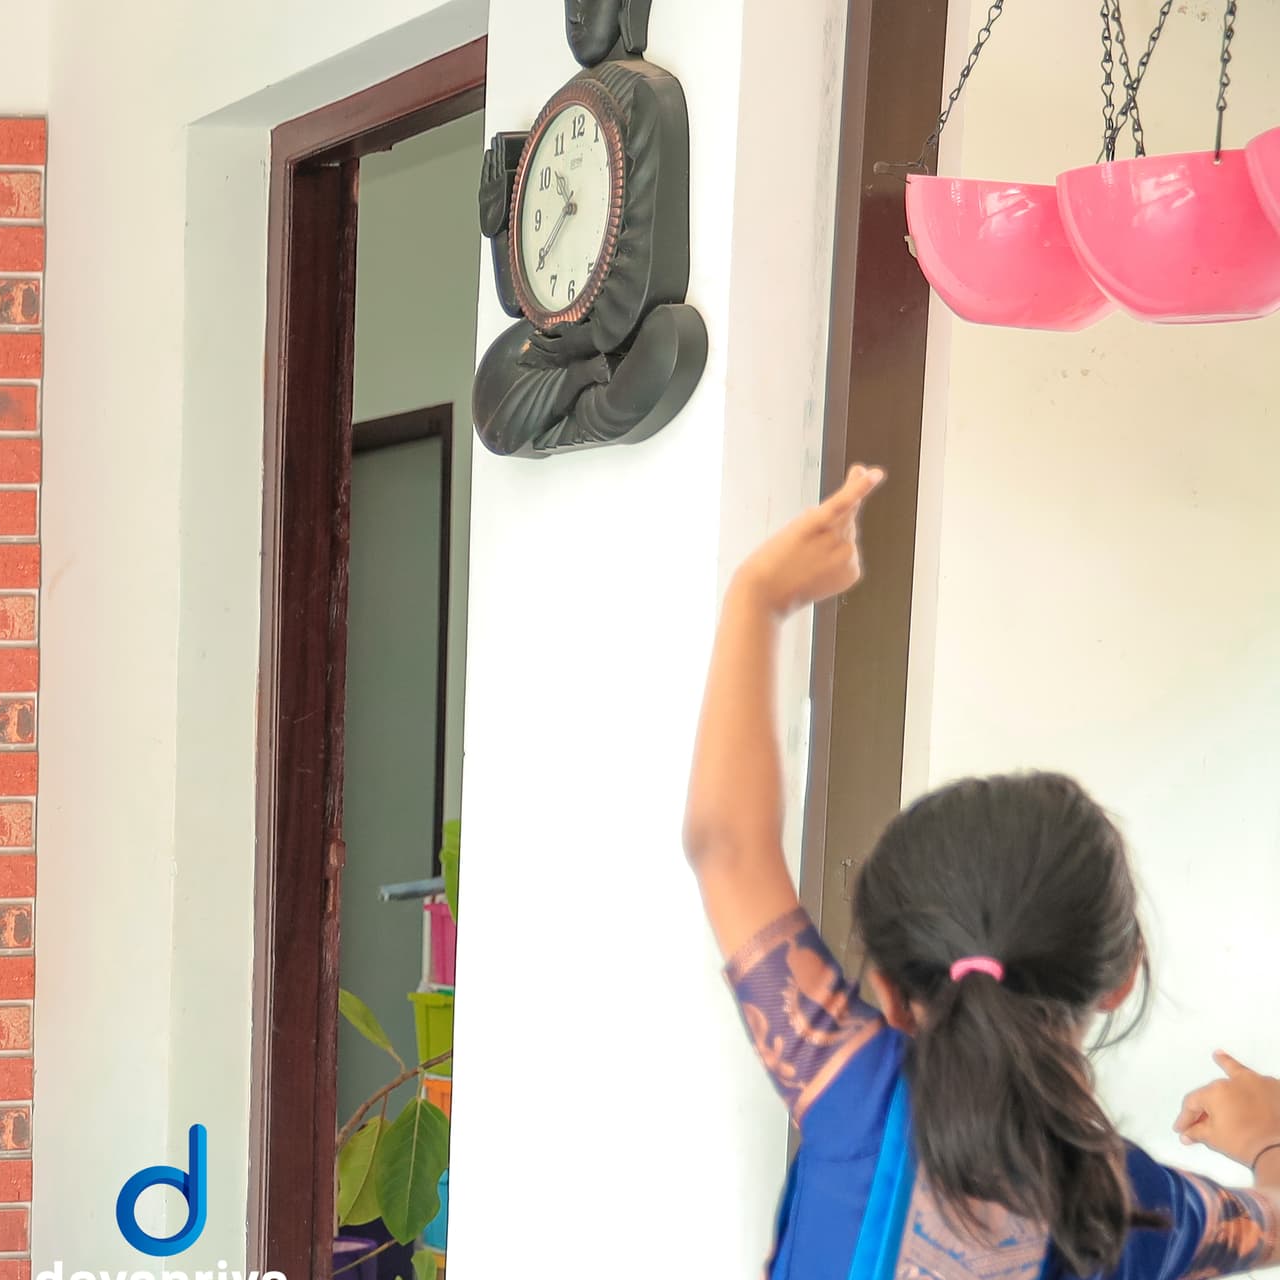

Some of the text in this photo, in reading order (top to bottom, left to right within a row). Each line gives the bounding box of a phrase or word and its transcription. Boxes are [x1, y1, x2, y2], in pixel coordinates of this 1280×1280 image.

[571, 113, 585, 139] 12
[593, 123, 600, 143] 1
[554, 132, 564, 157] 11
[539, 166, 551, 191] 10
[535, 209, 542, 232] 9
[550, 274, 557, 297] 7
[567, 279, 575, 302] 6
